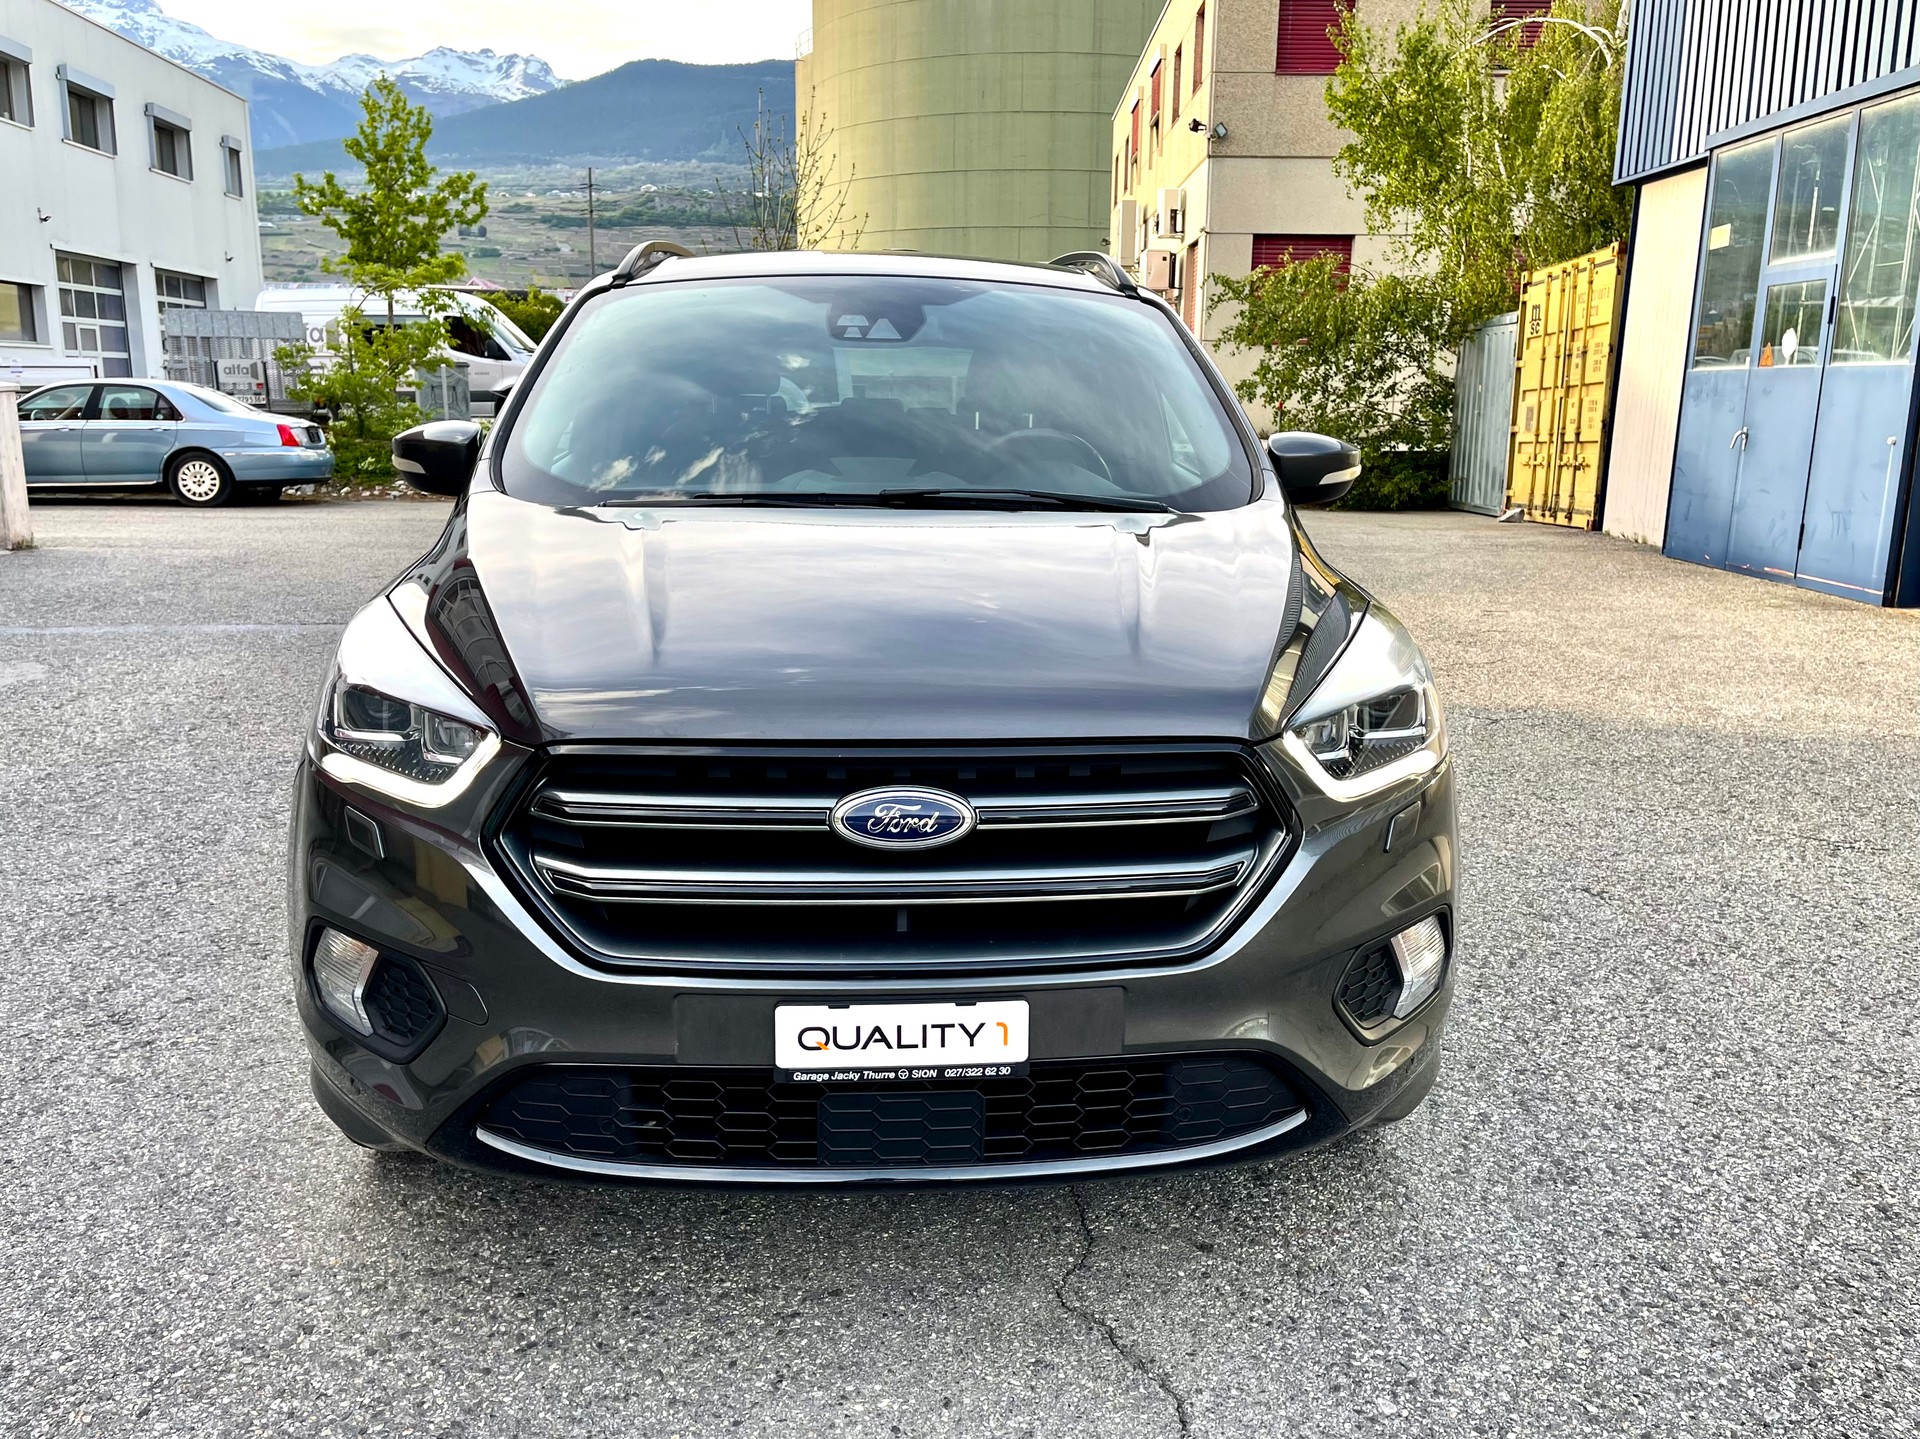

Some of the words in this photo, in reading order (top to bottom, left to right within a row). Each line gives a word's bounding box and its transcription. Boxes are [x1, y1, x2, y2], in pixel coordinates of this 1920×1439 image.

[223, 364, 249, 376] alfa
[867, 803, 940, 834] Ford
[797, 1022, 986, 1051] QUALITY
[996, 1021, 1008, 1046] 1
[793, 1071, 830, 1082] Garage
[831, 1071, 861, 1081] Jacky
[862, 1070, 896, 1080] Thurre
[911, 1068, 938, 1078] SION
[944, 1067, 983, 1078] 027/322
[984, 1066, 997, 1076] 62
[998, 1066, 1011, 1076] 30
